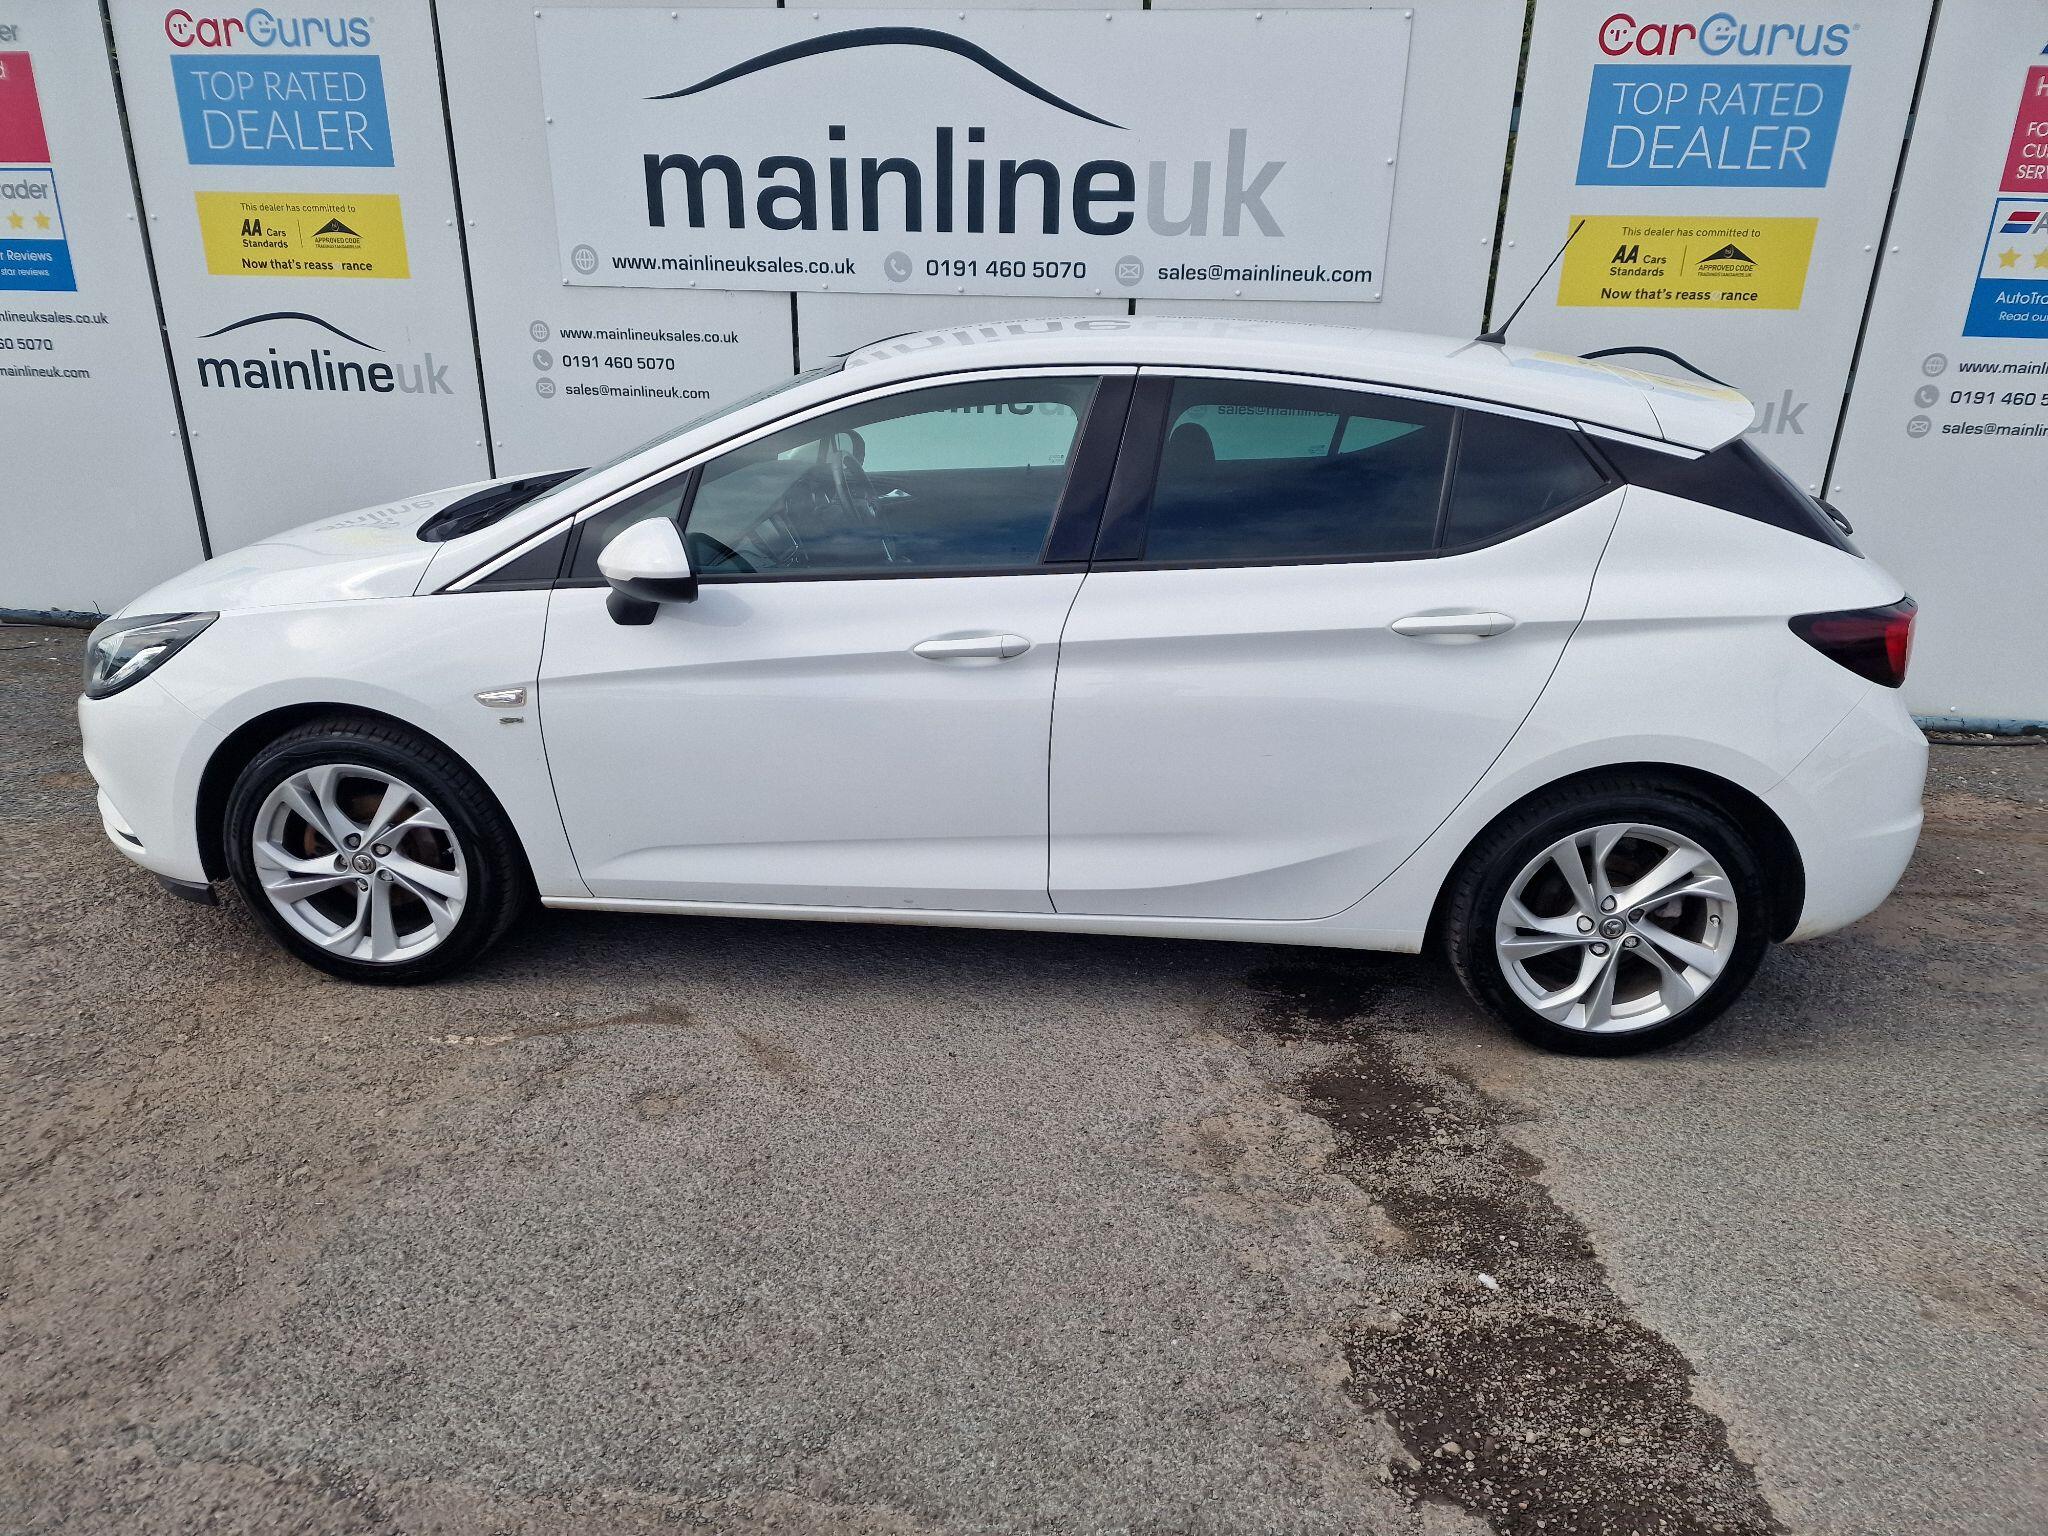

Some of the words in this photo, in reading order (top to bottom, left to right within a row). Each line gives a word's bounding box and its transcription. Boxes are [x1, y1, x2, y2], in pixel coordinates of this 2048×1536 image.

[164, 8, 371, 48] CarGurus
[1598, 12, 1850, 57] CarGurus
[190, 71, 254, 101] TOP
[264, 71, 367, 102] RATED
[1612, 82, 1688, 116] TOP
[1698, 82, 1824, 116] RATED
[203, 109, 374, 151] DEALER
[1606, 125, 1811, 171] DEALER
[0, 179, 48, 200] ader
[240, 202, 258, 212] This
[259, 202, 284, 213] dealer
[286, 203, 301, 213] has
[302, 204, 346, 214] committed
[347, 204, 357, 214] to
[241, 218, 262, 237] AA
[266, 228, 287, 238] Cars
[1622, 226, 1642, 237] This
[1643, 226, 1675, 237] dealer
[1676, 227, 1694, 237] has
[1695, 228, 1749, 238] committed
[1750, 229, 1761, 238] to
[242, 238, 289, 249] Standards
[6, 249, 53, 262] Reviews
[1611, 245, 1640, 264] AA
[1643, 255, 1667, 264] Cars
[241, 258, 268, 269] Now
[270, 258, 302, 270] that's
[612, 253, 856, 275] www.mainlineuksales.co.uk
[926, 259, 978, 277] 0191
[985, 260, 1026, 279] 460
[1032, 261, 1086, 279] 5070
[1609, 267, 1665, 277] Standards
[1698, 264, 1735, 272] APPROVED
[1735, 264, 1754, 272] CODE
[1157, 263, 1373, 283] sales@mainlineuk.com
[1601, 287, 1632, 300] Now
[1635, 288, 1672, 300] that's
[1999, 311, 2030, 321] Read
[560, 327, 739, 343] www.mainlineuksales.co.uk
[16, 338, 54, 351] 5070
[562, 355, 599, 367] 0191
[604, 357, 633, 369] 460
[637, 358, 675, 370] 5070
[565, 384, 710, 400] sales@mainlineuk.com
[1950, 390, 1996, 405] 0191
[2001, 392, 2037, 406] 460
